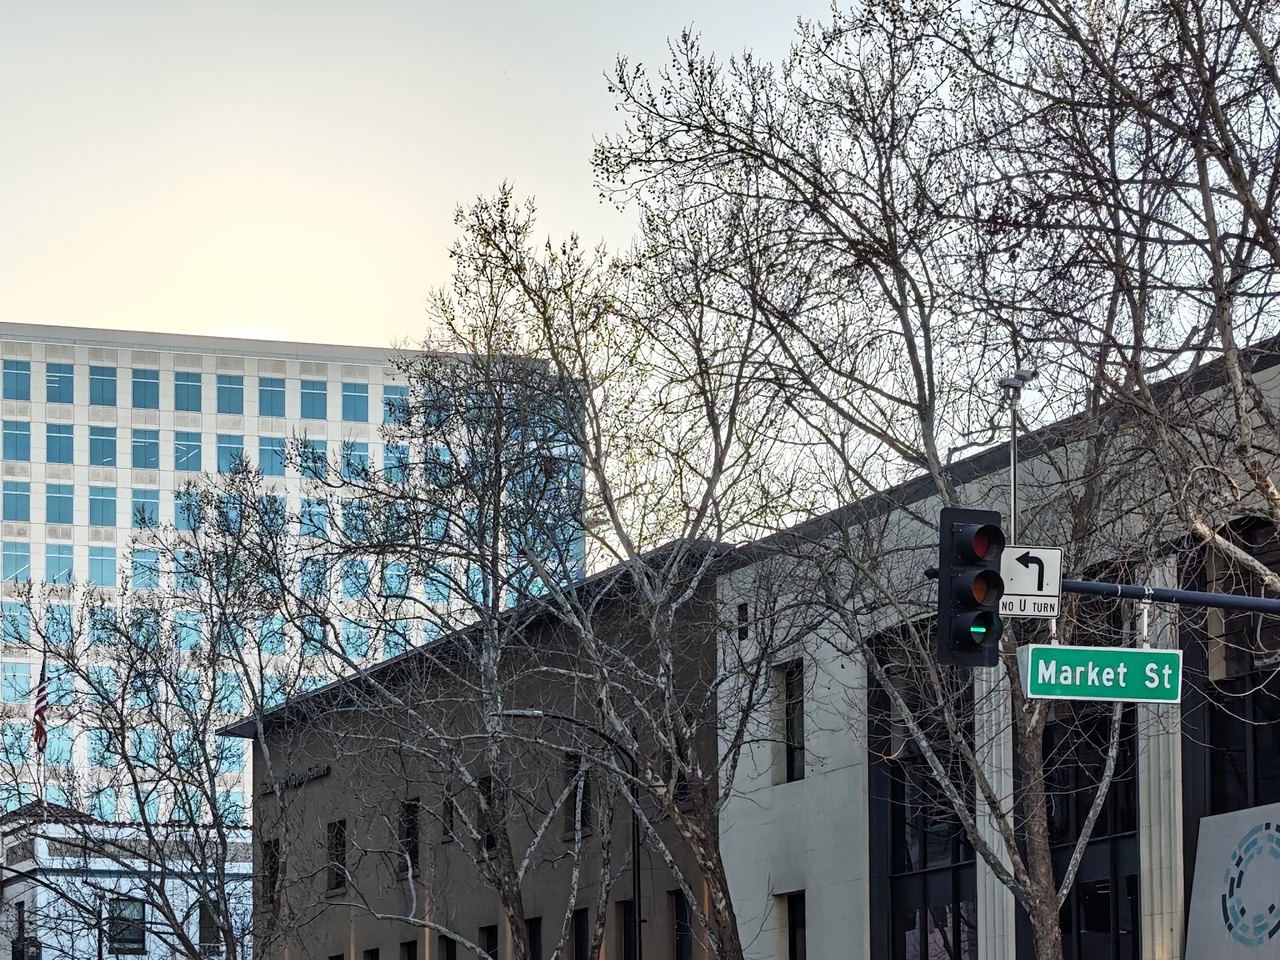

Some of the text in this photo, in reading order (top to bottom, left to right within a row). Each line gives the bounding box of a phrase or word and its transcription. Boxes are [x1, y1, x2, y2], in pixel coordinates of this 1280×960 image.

[1002, 599, 1056, 613] NO U TURN
[1037, 659, 1173, 689] Market St
